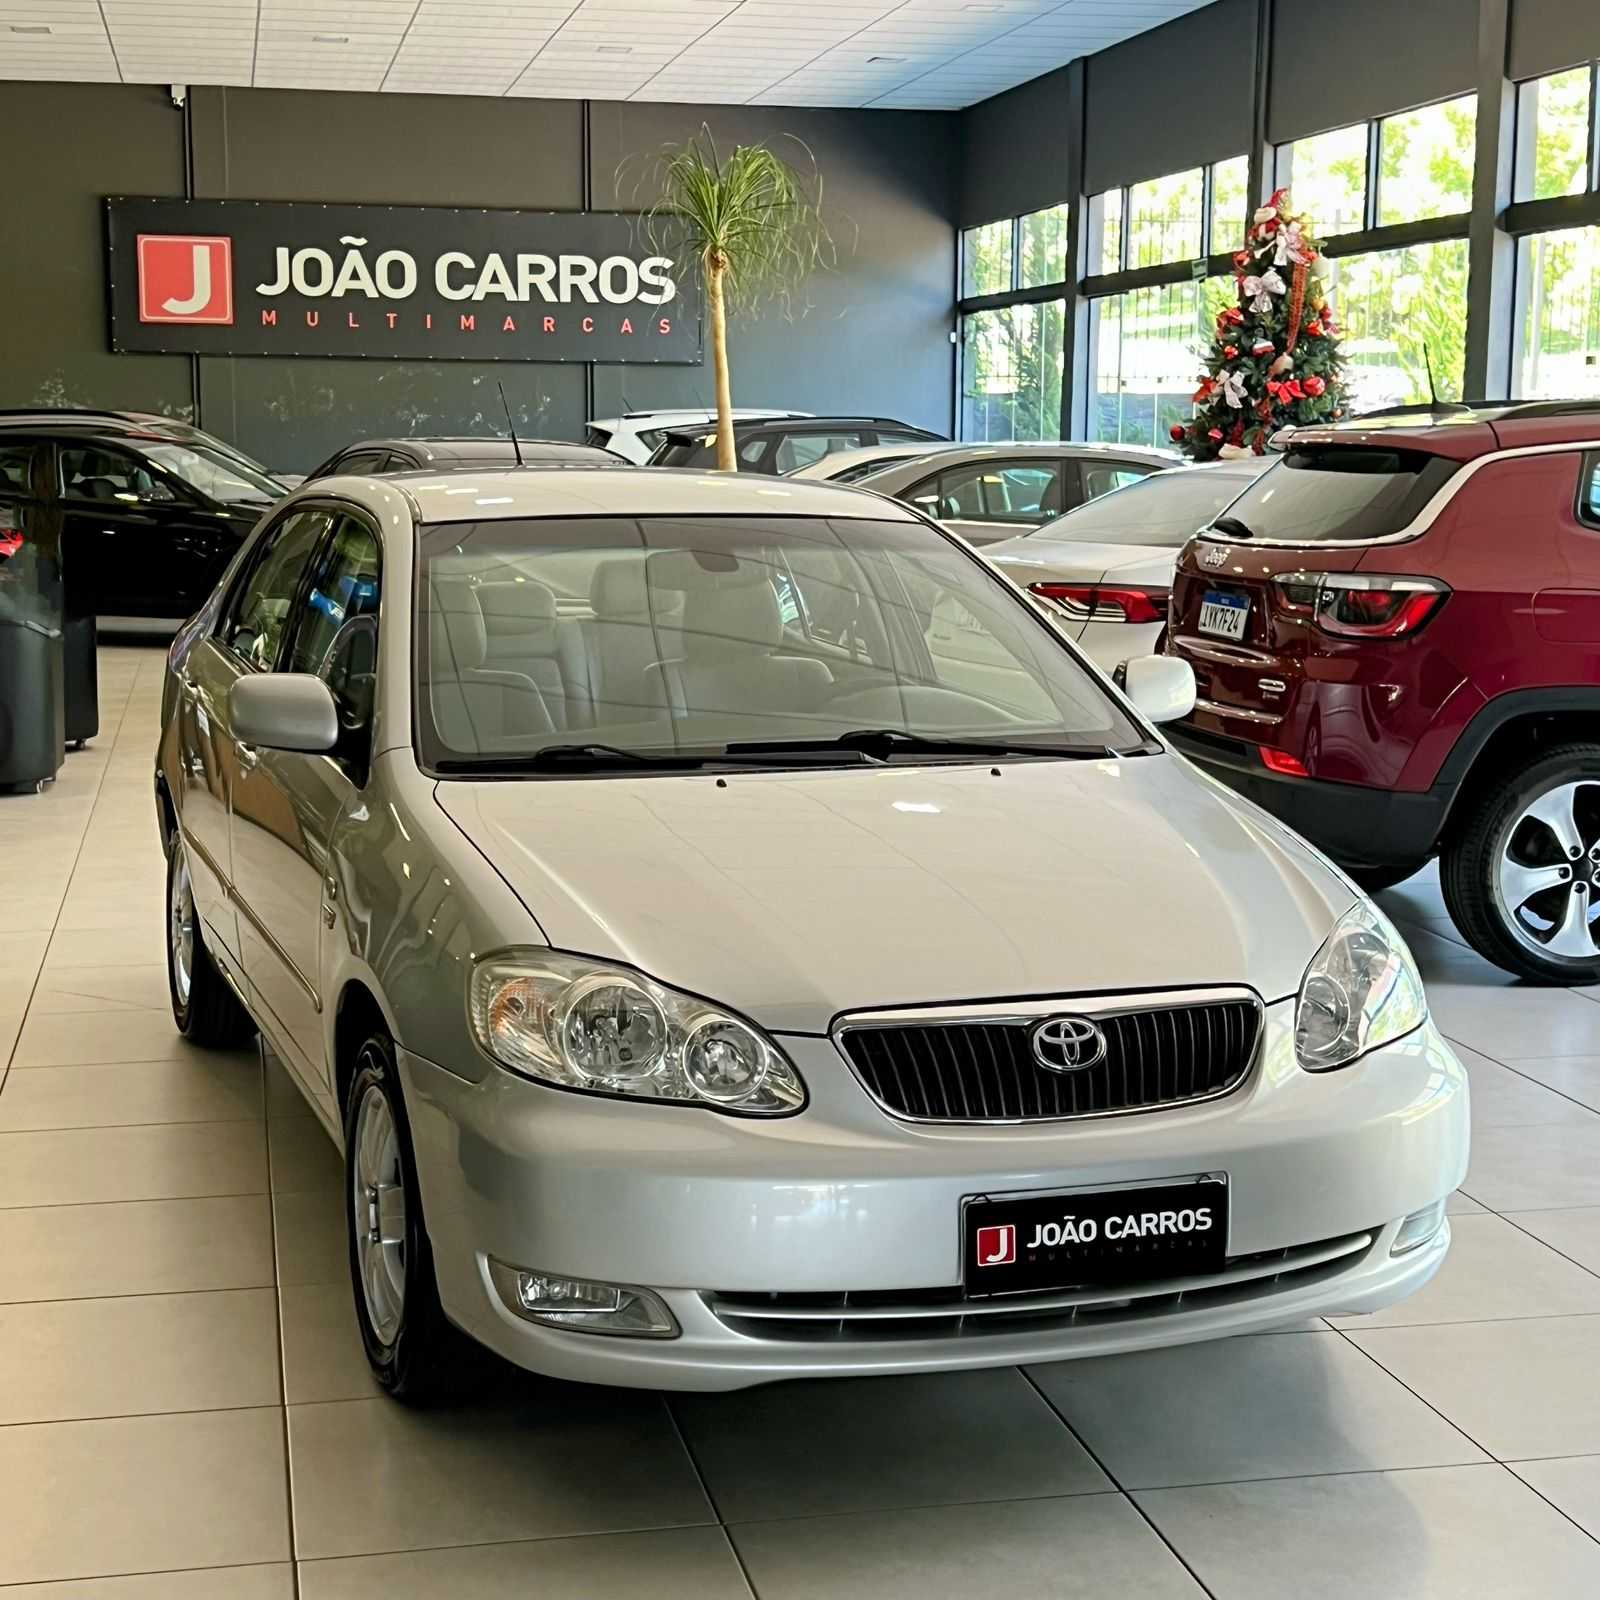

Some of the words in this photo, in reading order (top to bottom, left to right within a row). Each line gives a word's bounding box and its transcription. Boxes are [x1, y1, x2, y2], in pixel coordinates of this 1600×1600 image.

[161, 244, 212, 315] J
[255, 235, 417, 298] JOÃO
[435, 251, 676, 305] CARROS
[261, 309, 672, 335] MULTIMARCAS
[986, 1228, 1008, 1263] J
[1026, 1215, 1098, 1248] JOÃO
[1104, 1208, 1213, 1239] CARROS
